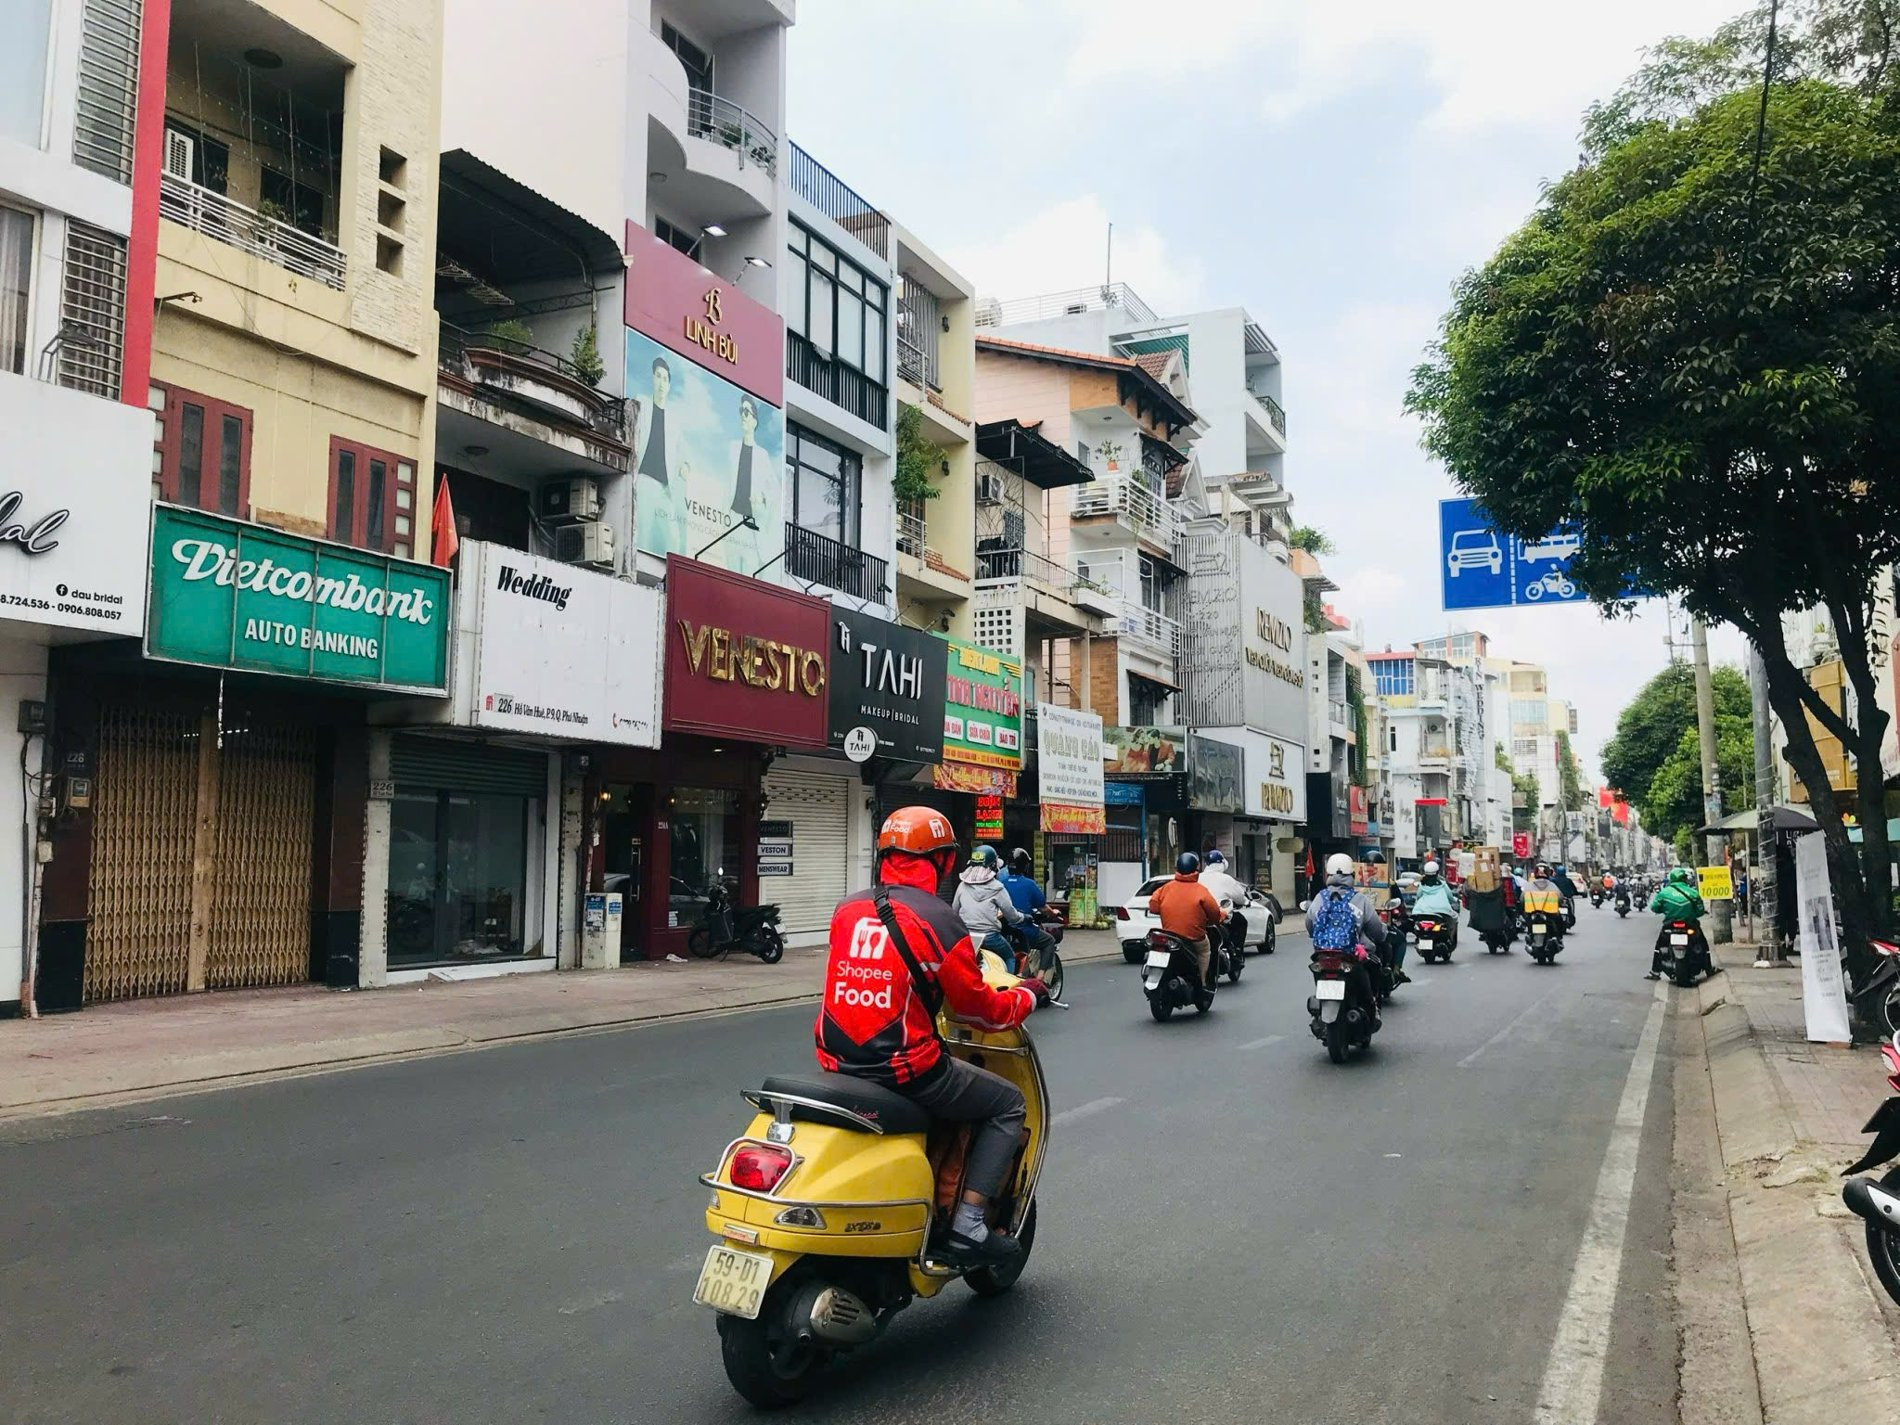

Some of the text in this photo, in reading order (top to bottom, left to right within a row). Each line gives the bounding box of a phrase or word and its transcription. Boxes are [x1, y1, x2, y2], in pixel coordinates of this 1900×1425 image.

[684, 315, 717, 353] LINH
[685, 497, 732, 528] VENESTO
[72, 589, 123, 605] dau bridal
[172, 538, 433, 625] Vietcombank
[497, 565, 573, 612] Wedding
[57, 602, 122, 620] 0906.808.057
[245, 619, 378, 660] AUTO BANKING
[677, 619, 826, 698] VENESTO
[860, 641, 924, 701] TAHI
[498, 698, 513, 715] 226
[849, 742, 870, 752] TAHI
[760, 846, 787, 854] VESTON
[837, 960, 893, 984] Shopee
[834, 982, 892, 1009] Food
[699, 1276, 760, 1312] 108.29
